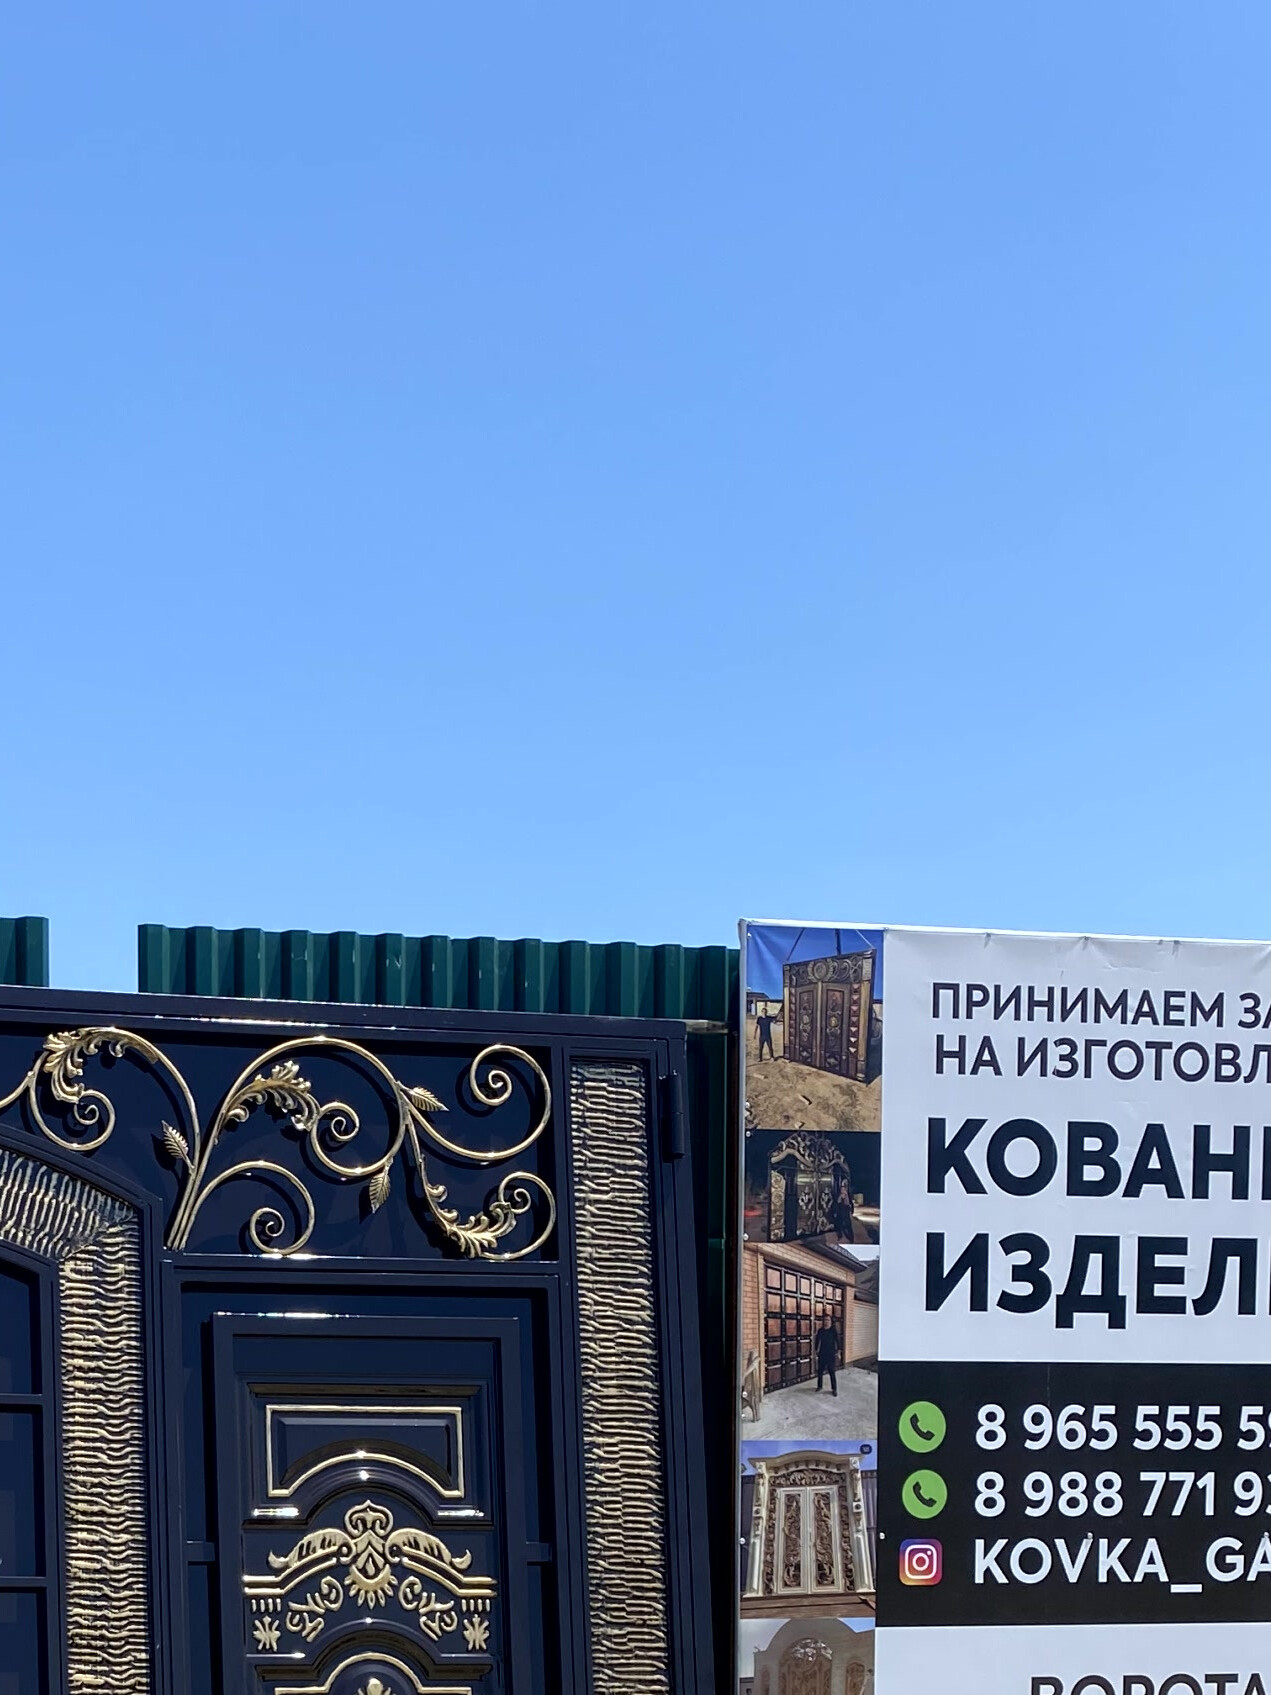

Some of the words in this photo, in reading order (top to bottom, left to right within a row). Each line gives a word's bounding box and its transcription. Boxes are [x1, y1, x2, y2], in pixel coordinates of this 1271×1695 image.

[933, 983, 1224, 1027] ПРИНИМАЕМ
[1237, 992, 1271, 1029] З
[935, 1035, 1002, 1076] НА
[1017, 1037, 1271, 1084] ИЗГОТОВЛ
[927, 1118, 1271, 1200] КОВАН
[925, 1232, 1271, 1329] ИЗДЕЛ
[976, 1404, 1006, 1450] 8
[1024, 1404, 1118, 1450] 965
[1133, 1405, 1223, 1450] 555
[1237, 1405, 1271, 1450] 5
[975, 1471, 1006, 1517] 8
[1024, 1471, 1123, 1517] 988
[1139, 1471, 1215, 1516] 771
[1233, 1471, 1271, 1517] 9
